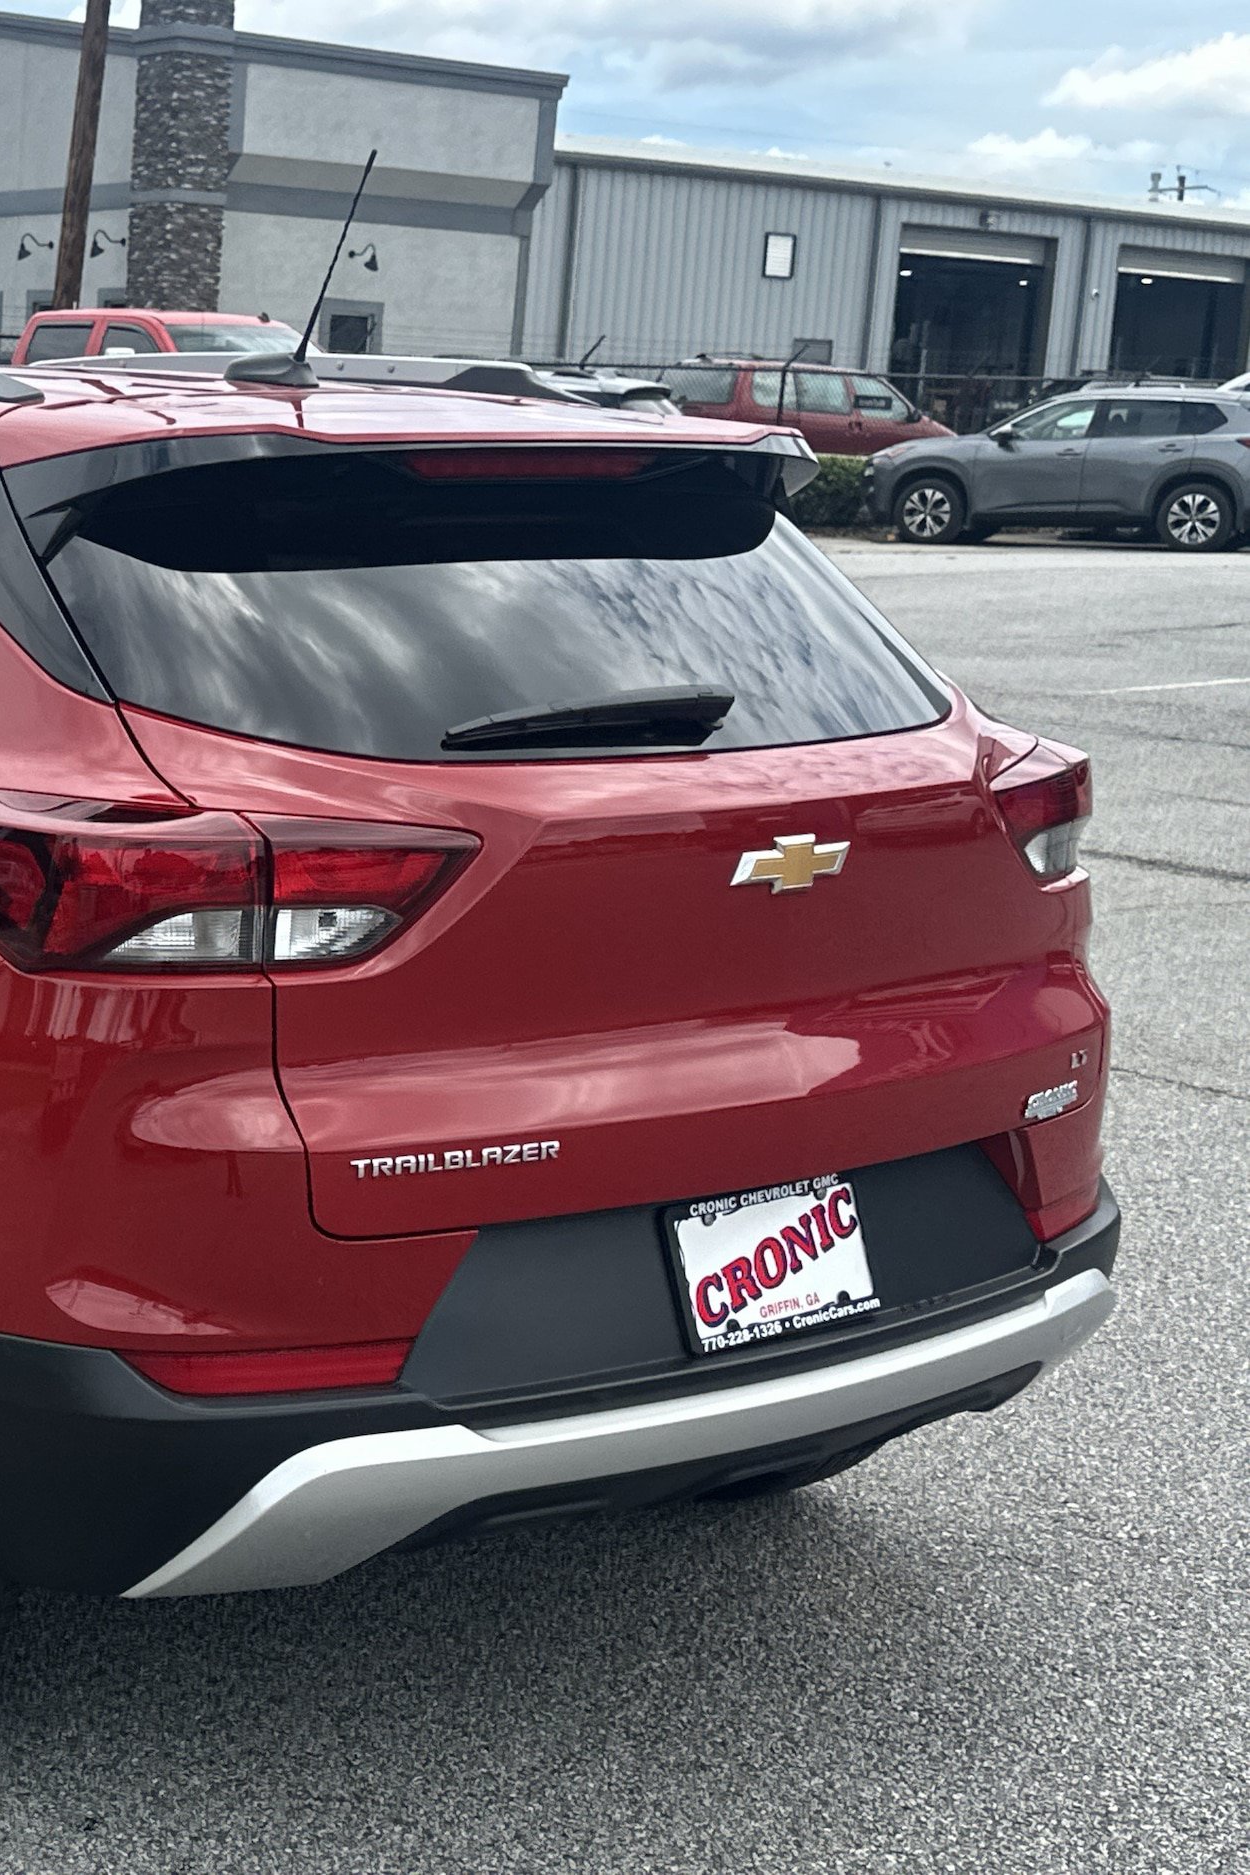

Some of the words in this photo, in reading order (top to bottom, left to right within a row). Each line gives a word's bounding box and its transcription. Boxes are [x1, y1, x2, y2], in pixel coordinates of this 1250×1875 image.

[350, 1140, 561, 1179] TRAILBLAZER
[689, 1196, 738, 1217] CRONIC
[739, 1179, 811, 1207] CHEVROLET
[812, 1172, 840, 1190] GMC
[695, 1186, 858, 1328] CRONIC
[701, 1320, 784, 1353] 770-228-1326
[792, 1296, 882, 1330] CronicCars.com
[759, 1297, 805, 1319] GRIFFIN,
[805, 1292, 821, 1306] GA
